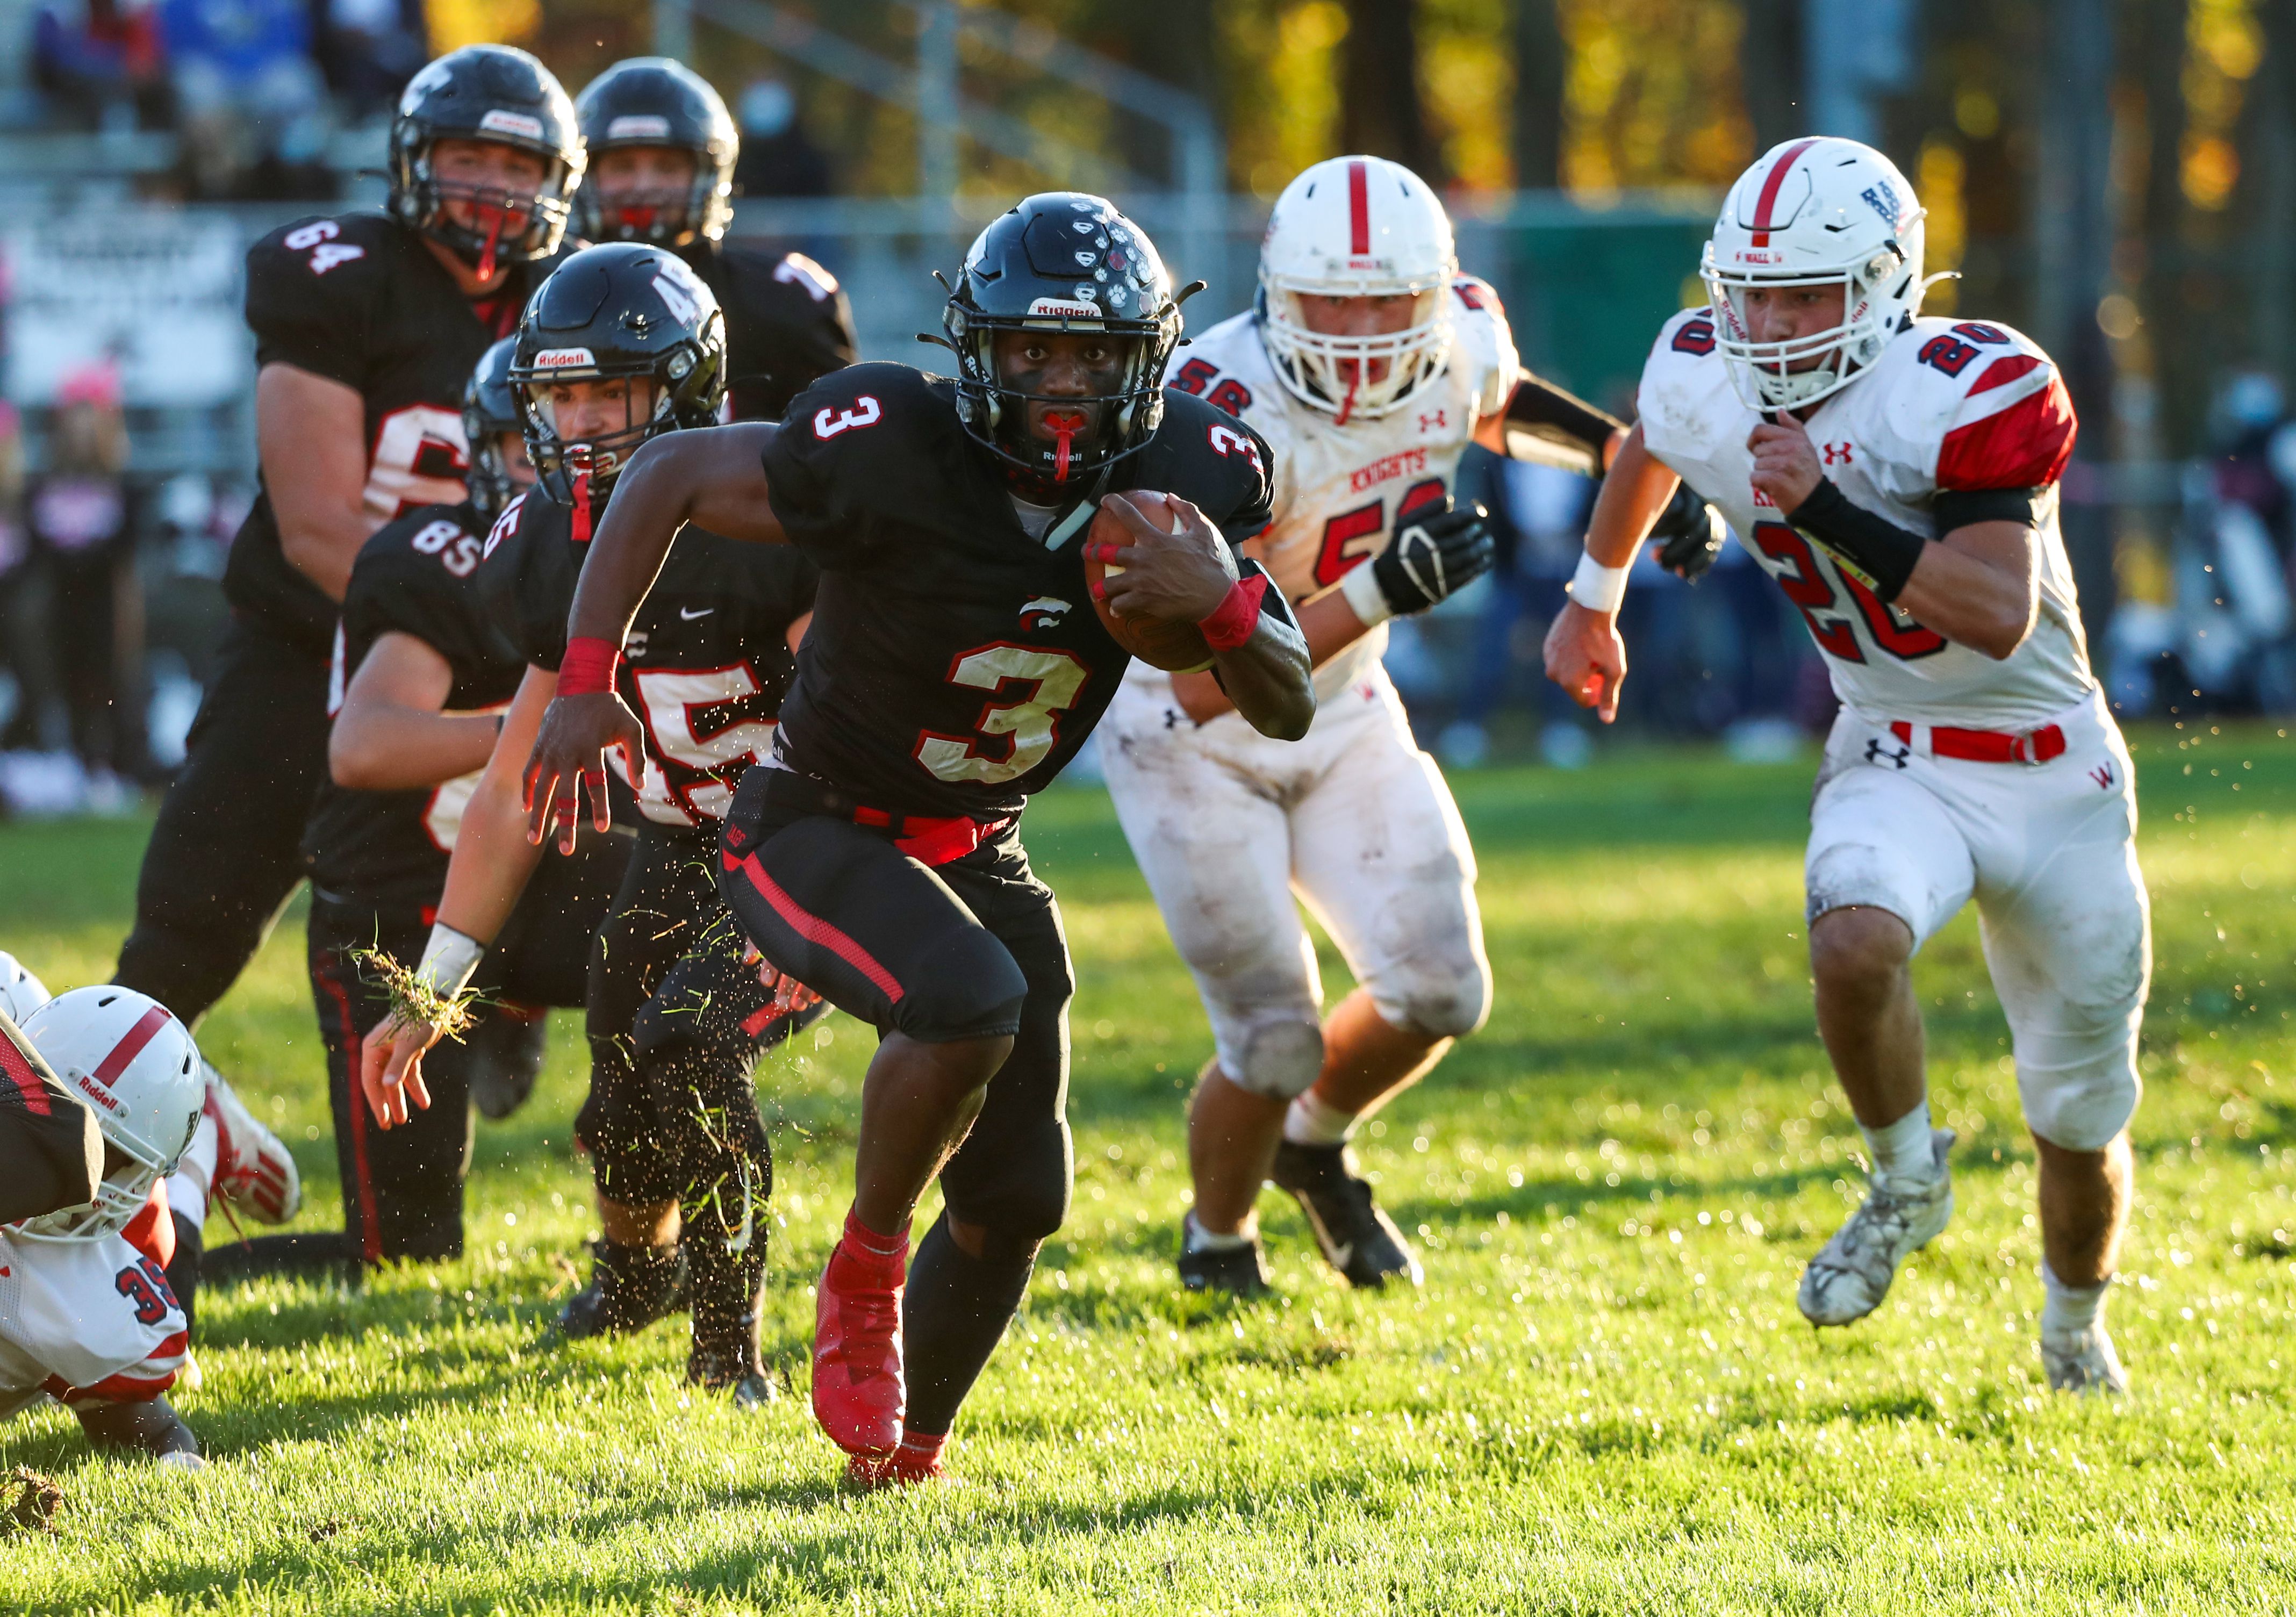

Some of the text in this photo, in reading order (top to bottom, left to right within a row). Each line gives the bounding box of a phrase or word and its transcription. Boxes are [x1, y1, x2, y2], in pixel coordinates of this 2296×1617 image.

[283, 219, 370, 277] 64
[539, 354, 584, 365] Riddell
[1917, 322, 2011, 379] 20
[1167, 357, 1253, 418] 56
[812, 393, 885, 442] 3
[1043, 451, 1082, 462] Riell
[1207, 423, 1266, 474] 3
[1350, 445, 1427, 495] KNIGHTS
[411, 519, 484, 577] 85
[912, 641, 1093, 786] 3
[2089, 761, 2114, 789] W
[78, 1075, 118, 1111] Riddell
